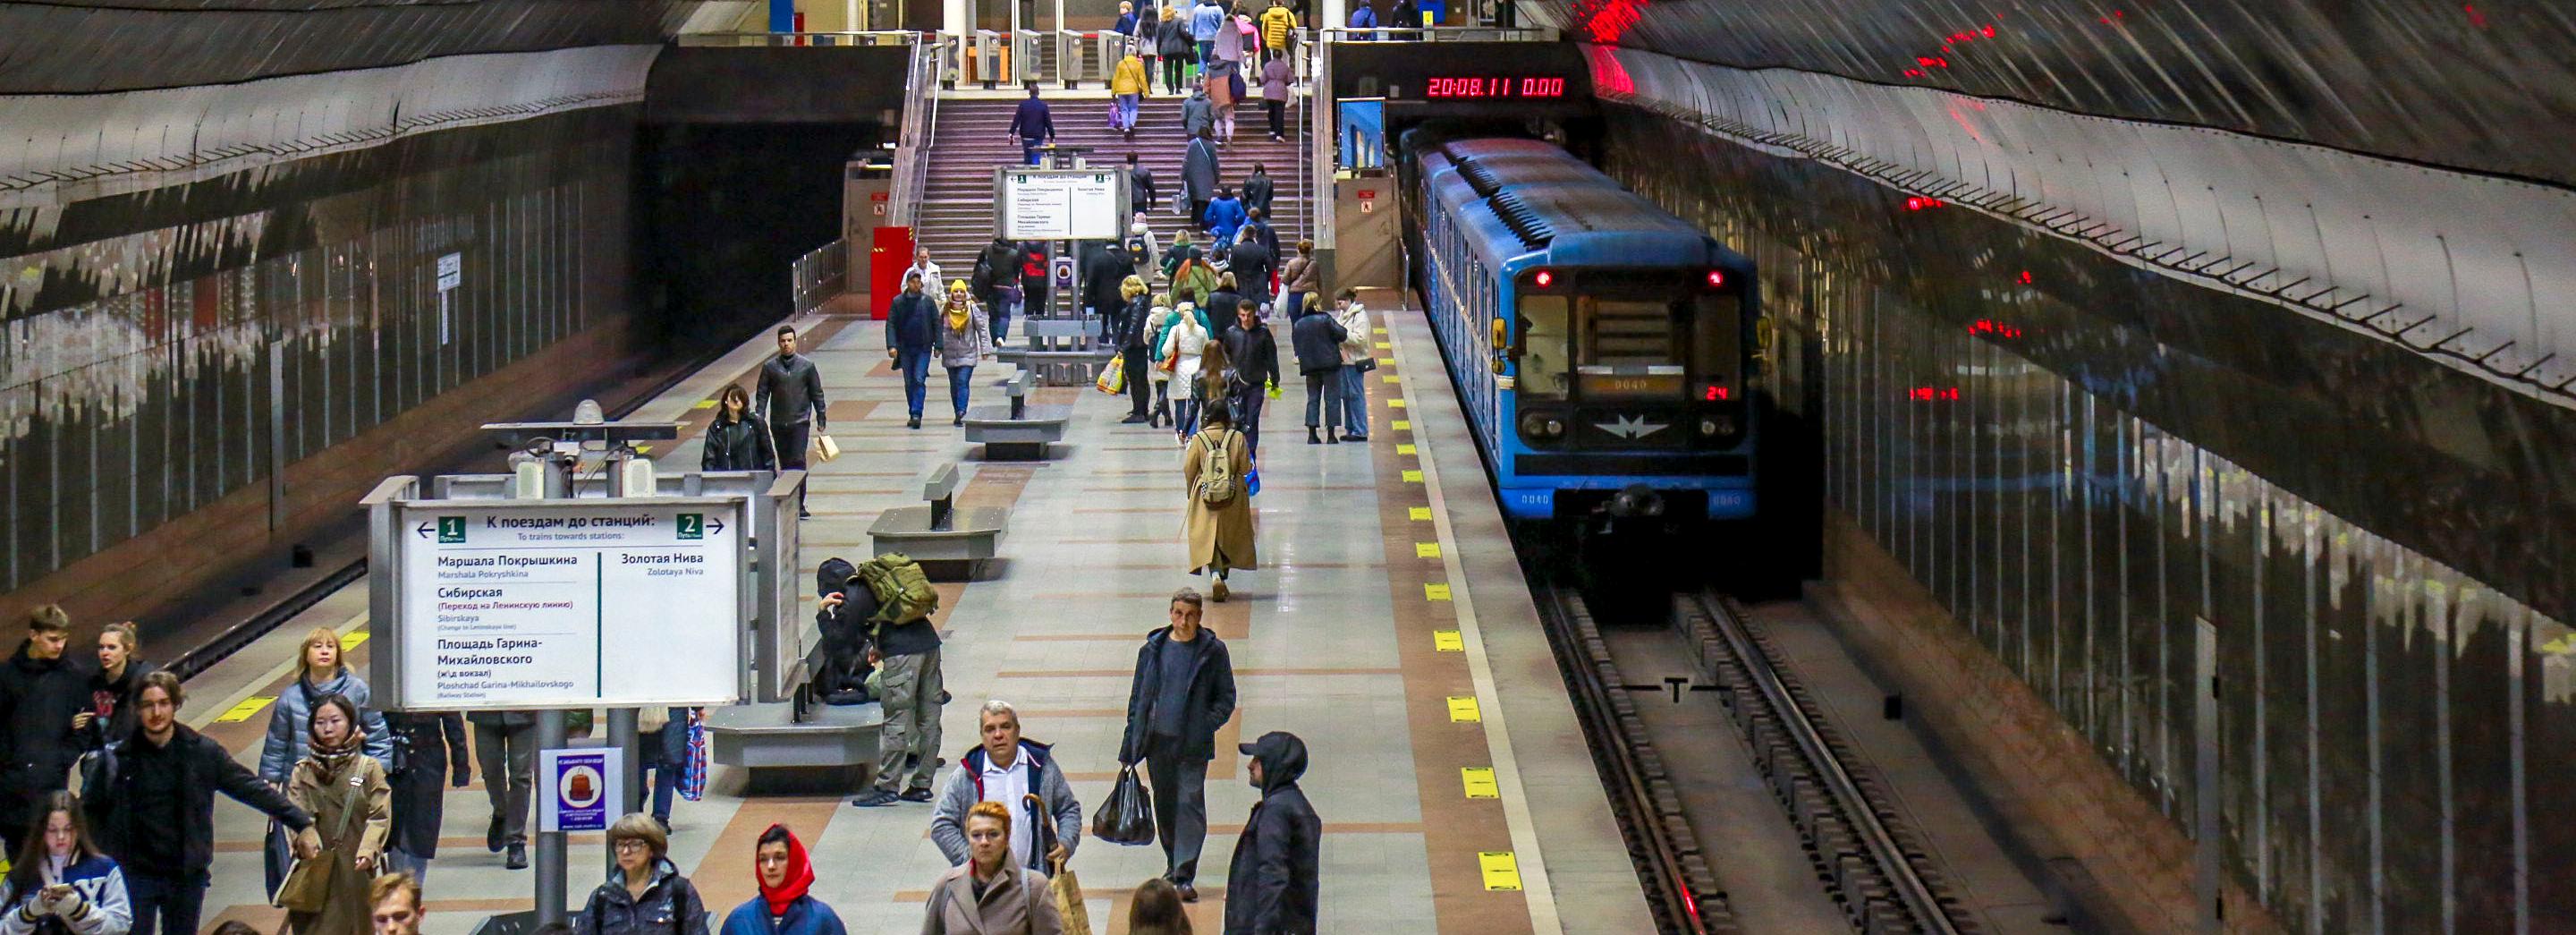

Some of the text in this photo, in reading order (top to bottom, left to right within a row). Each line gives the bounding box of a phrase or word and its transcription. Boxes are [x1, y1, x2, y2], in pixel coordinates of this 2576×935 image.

[1521, 78, 1565, 97] 0.00
[1706, 386, 1729, 401] 24
[447, 519, 459, 536] 1
[487, 514, 656, 529] К поездам до станций:
[685, 515, 696, 532] 2
[530, 532, 553, 540] trains
[555, 531, 588, 540] towards
[589, 531, 625, 540] stations:
[438, 555, 578, 568] Маршала Покрышкина
[622, 553, 704, 565] Золотая Нива
[438, 570, 530, 580] Marshala Pokryshkina
[648, 567, 704, 577] Zolotaya Niva
[437, 587, 503, 599] Сибирская
[438, 602, 479, 611] (Переход
[492, 601, 540, 610] Ленинскую
[542, 600, 573, 610] линию)
[438, 615, 479, 624] Sibirskaya
[437, 637, 543, 650] Площадь Гарина-
[437, 654, 533, 666] Михайловского
[459, 669, 492, 678] вокзал)
[437, 682, 479, 690] Ploshchad
